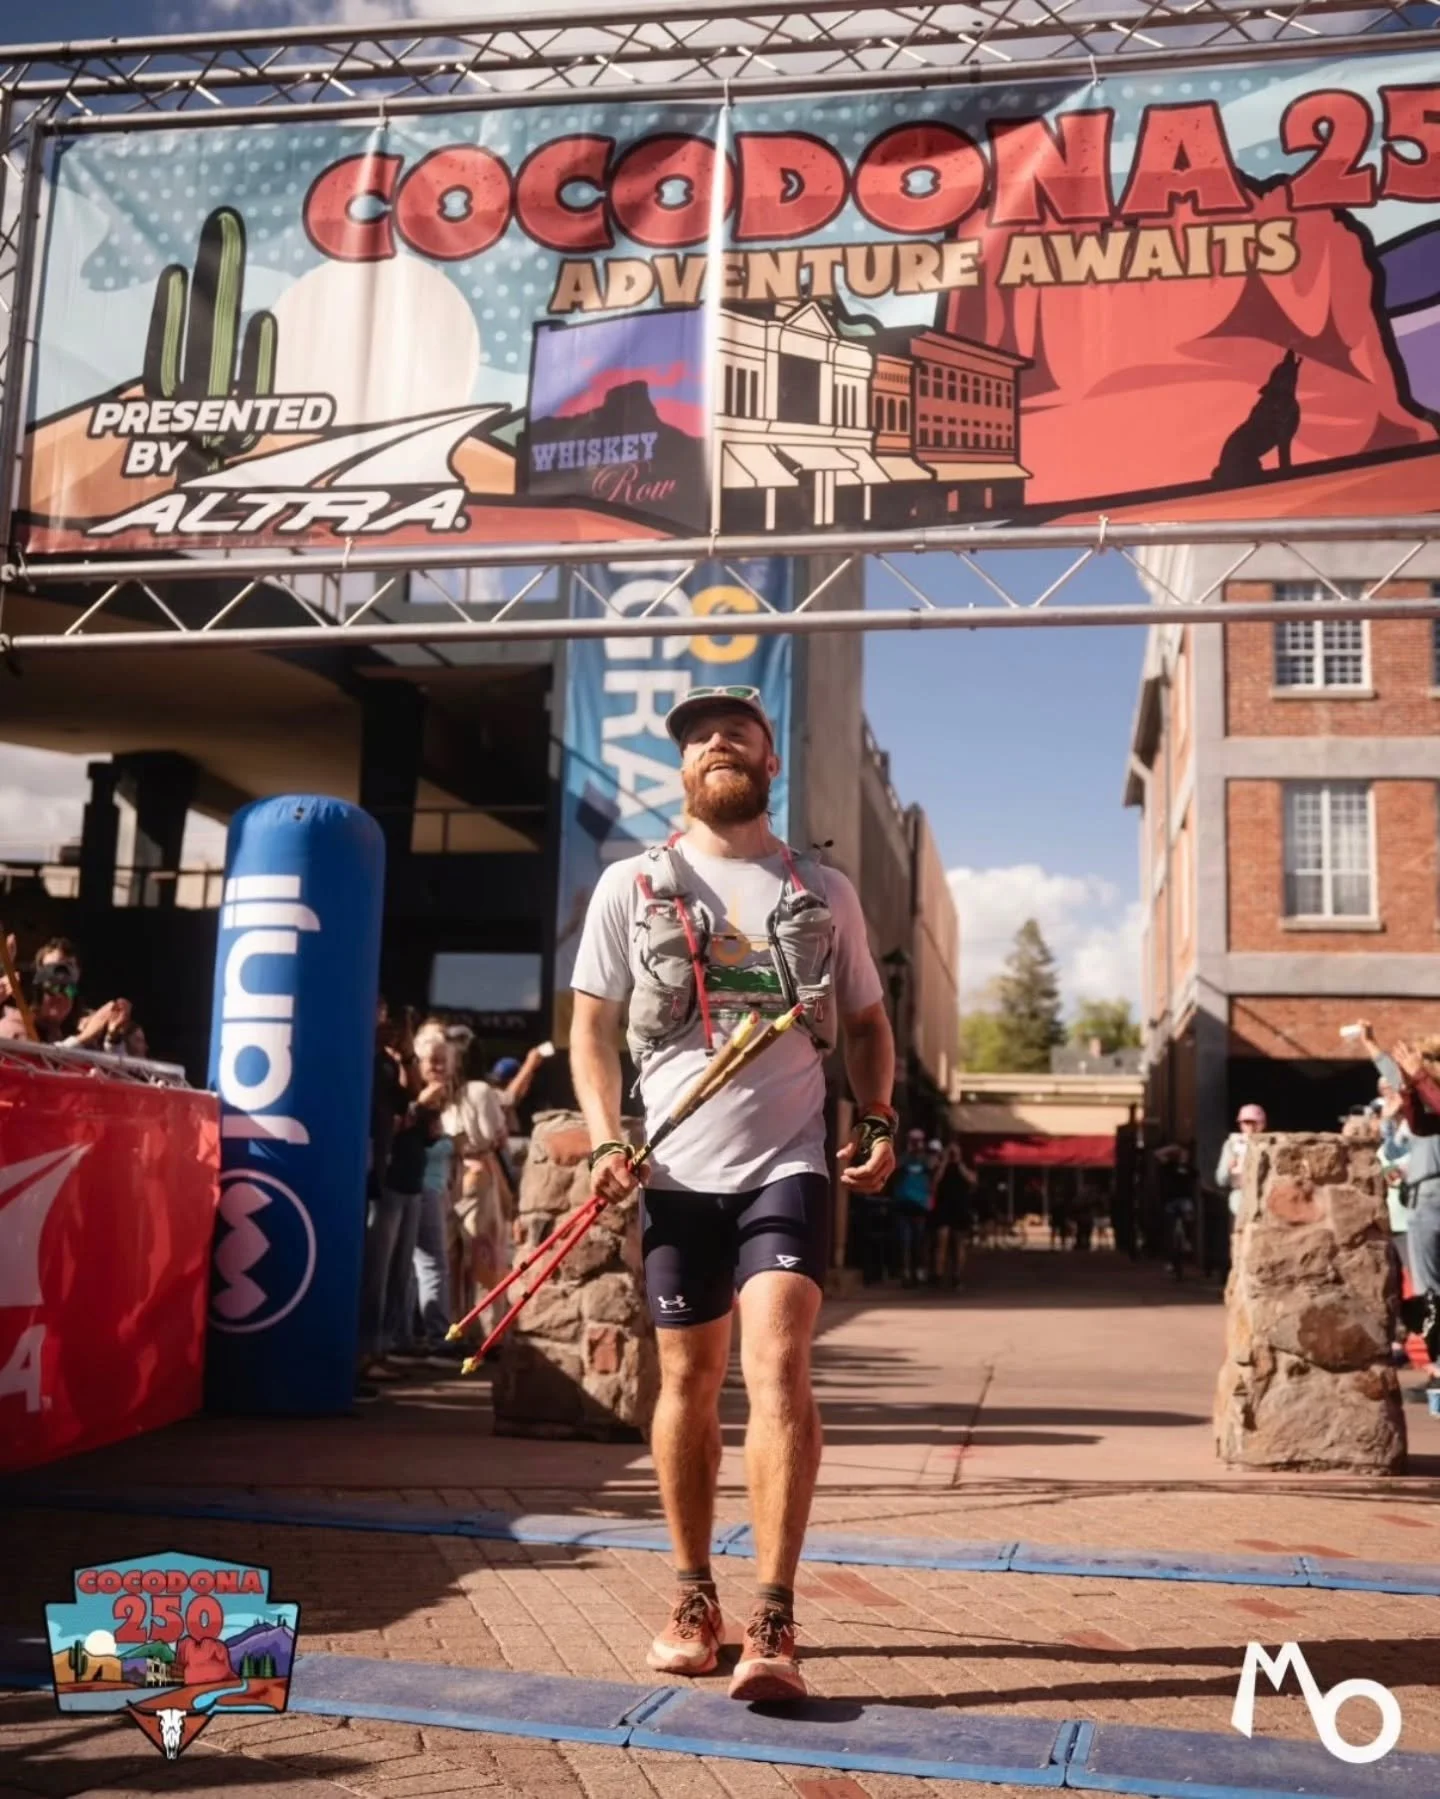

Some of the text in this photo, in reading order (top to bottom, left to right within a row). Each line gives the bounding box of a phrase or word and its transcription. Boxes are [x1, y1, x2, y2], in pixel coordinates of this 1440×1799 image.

[303, 100, 1254, 262] COCODONA
[547, 217, 1298, 314] ADVENTURE AWAITS
[92, 396, 333, 434] PRESENTED
[126, 440, 188, 475] BY
[531, 432, 658, 472] WHISKEY
[592, 463, 675, 503] Row
